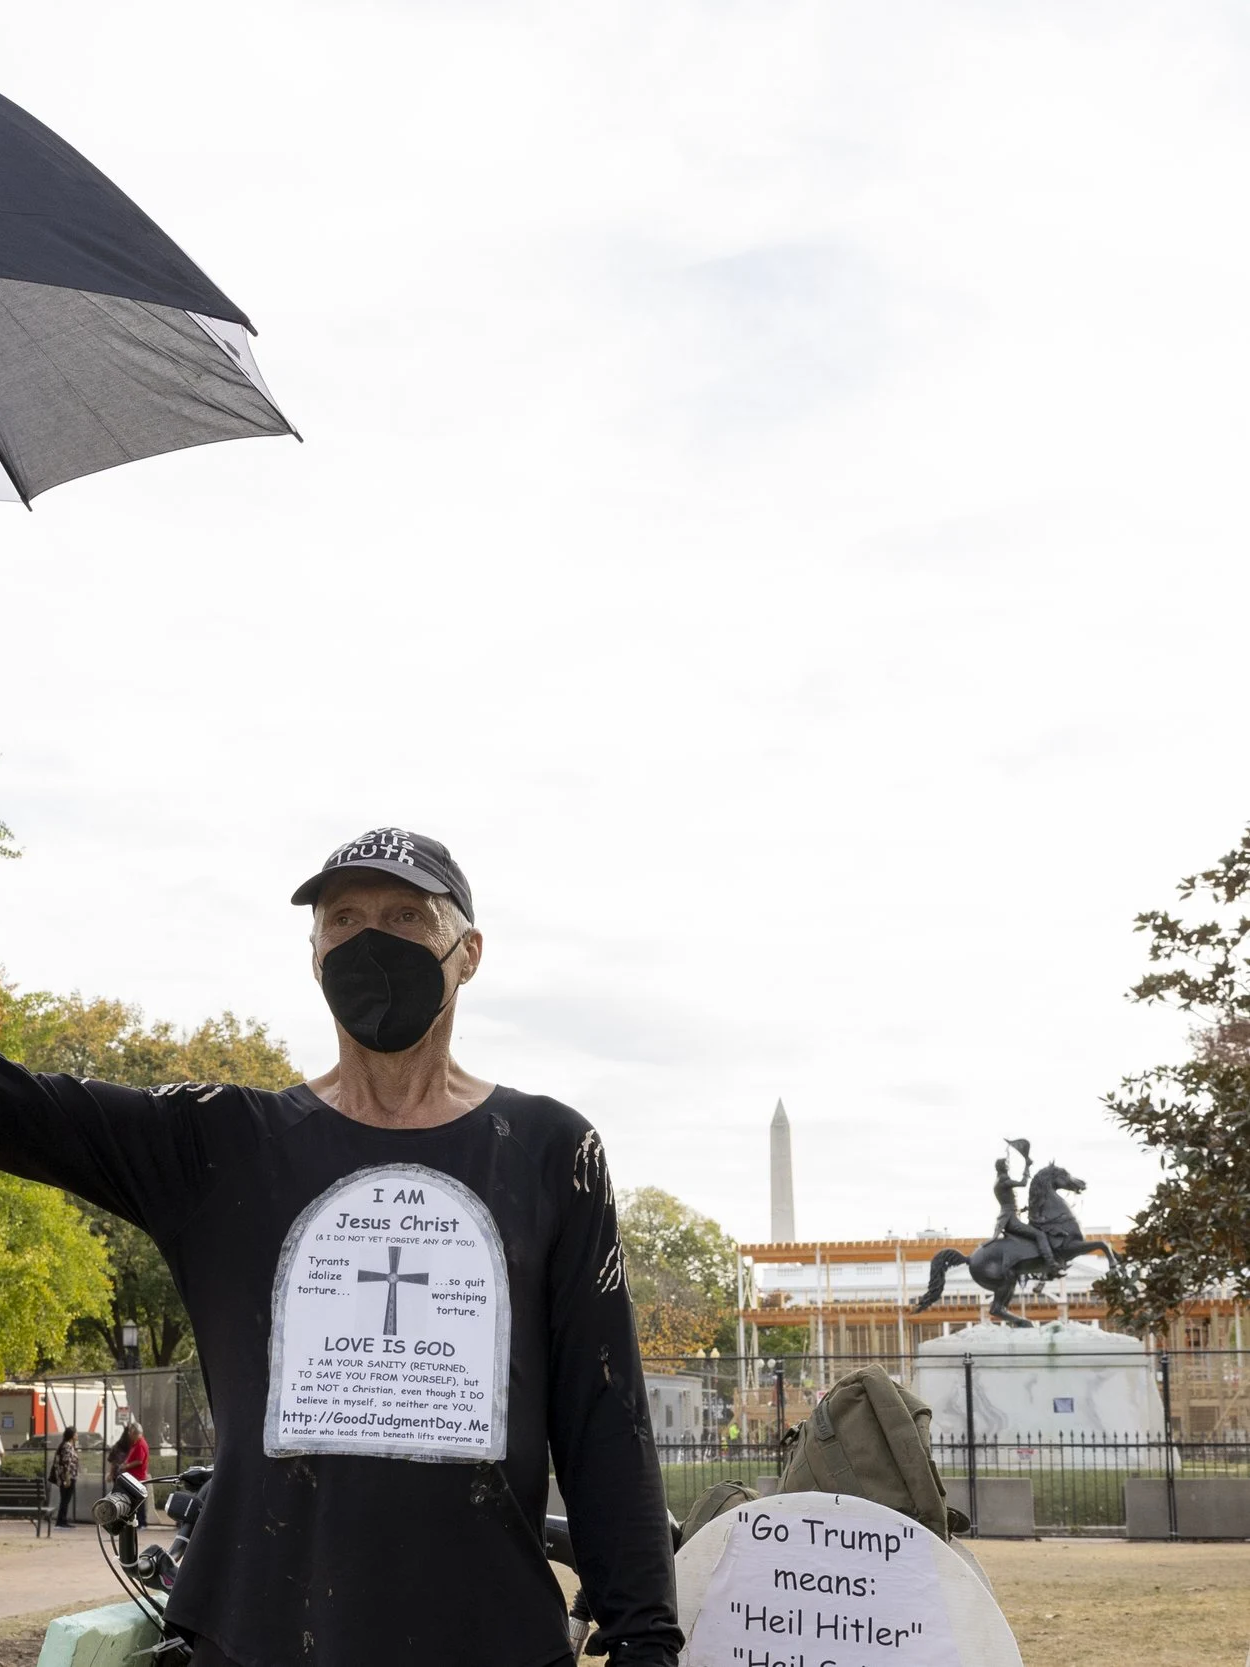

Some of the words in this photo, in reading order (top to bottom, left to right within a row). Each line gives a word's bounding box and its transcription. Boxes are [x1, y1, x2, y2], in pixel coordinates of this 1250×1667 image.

[373, 1189, 383, 1203] I
[393, 1189, 425, 1205] AM
[336, 1214, 390, 1230] Jesus
[400, 1215, 459, 1232] Christ
[386, 1236, 419, 1244] FORGIVE
[309, 1256, 350, 1266] Tyrants
[308, 1271, 341, 1280] idolize
[297, 1285, 350, 1296] torture...
[436, 1278, 460, 1286] ...so
[465, 1278, 485, 1289] quit
[432, 1292, 486, 1304] worshiping
[436, 1307, 479, 1317] torture.
[325, 1337, 374, 1352] LOVE
[383, 1339, 406, 1354] IS
[414, 1341, 455, 1357] GOD
[336, 1359, 363, 1367] YOUR
[367, 1361, 406, 1369] SANITY
[410, 1361, 469, 1374] (RETURNED,
[316, 1371, 341, 1379] SAVE
[346, 1372, 366, 1380] YOU
[370, 1373, 398, 1381] FROM
[402, 1374, 459, 1386] YOURSELF),
[464, 1378, 479, 1386] but
[317, 1384, 339, 1392] NOT
[353, 1385, 396, 1395] Christian,
[426, 1389, 456, 1399] though
[470, 1391, 484, 1399] DO
[296, 1397, 327, 1405] believe
[344, 1398, 377, 1408] myself,
[396, 1400, 429, 1408] neither
[451, 1403, 476, 1412] YOU.
[282, 1410, 489, 1432] http://GoodJudgmentDay.Me
[292, 1428, 316, 1436] leader
[320, 1428, 334, 1436] who
[361, 1429, 380, 1437] from
[383, 1430, 415, 1440] beneath
[418, 1432, 434, 1440] lifts
[438, 1434, 472, 1443] everyone
[476, 1436, 487, 1444] up.
[738, 1512, 789, 1542] "Go
[802, 1519, 914, 1561] Trump"
[774, 1568, 875, 1596] means:
[731, 1602, 802, 1636] "Heil
[817, 1612, 922, 1648] Hitler"
